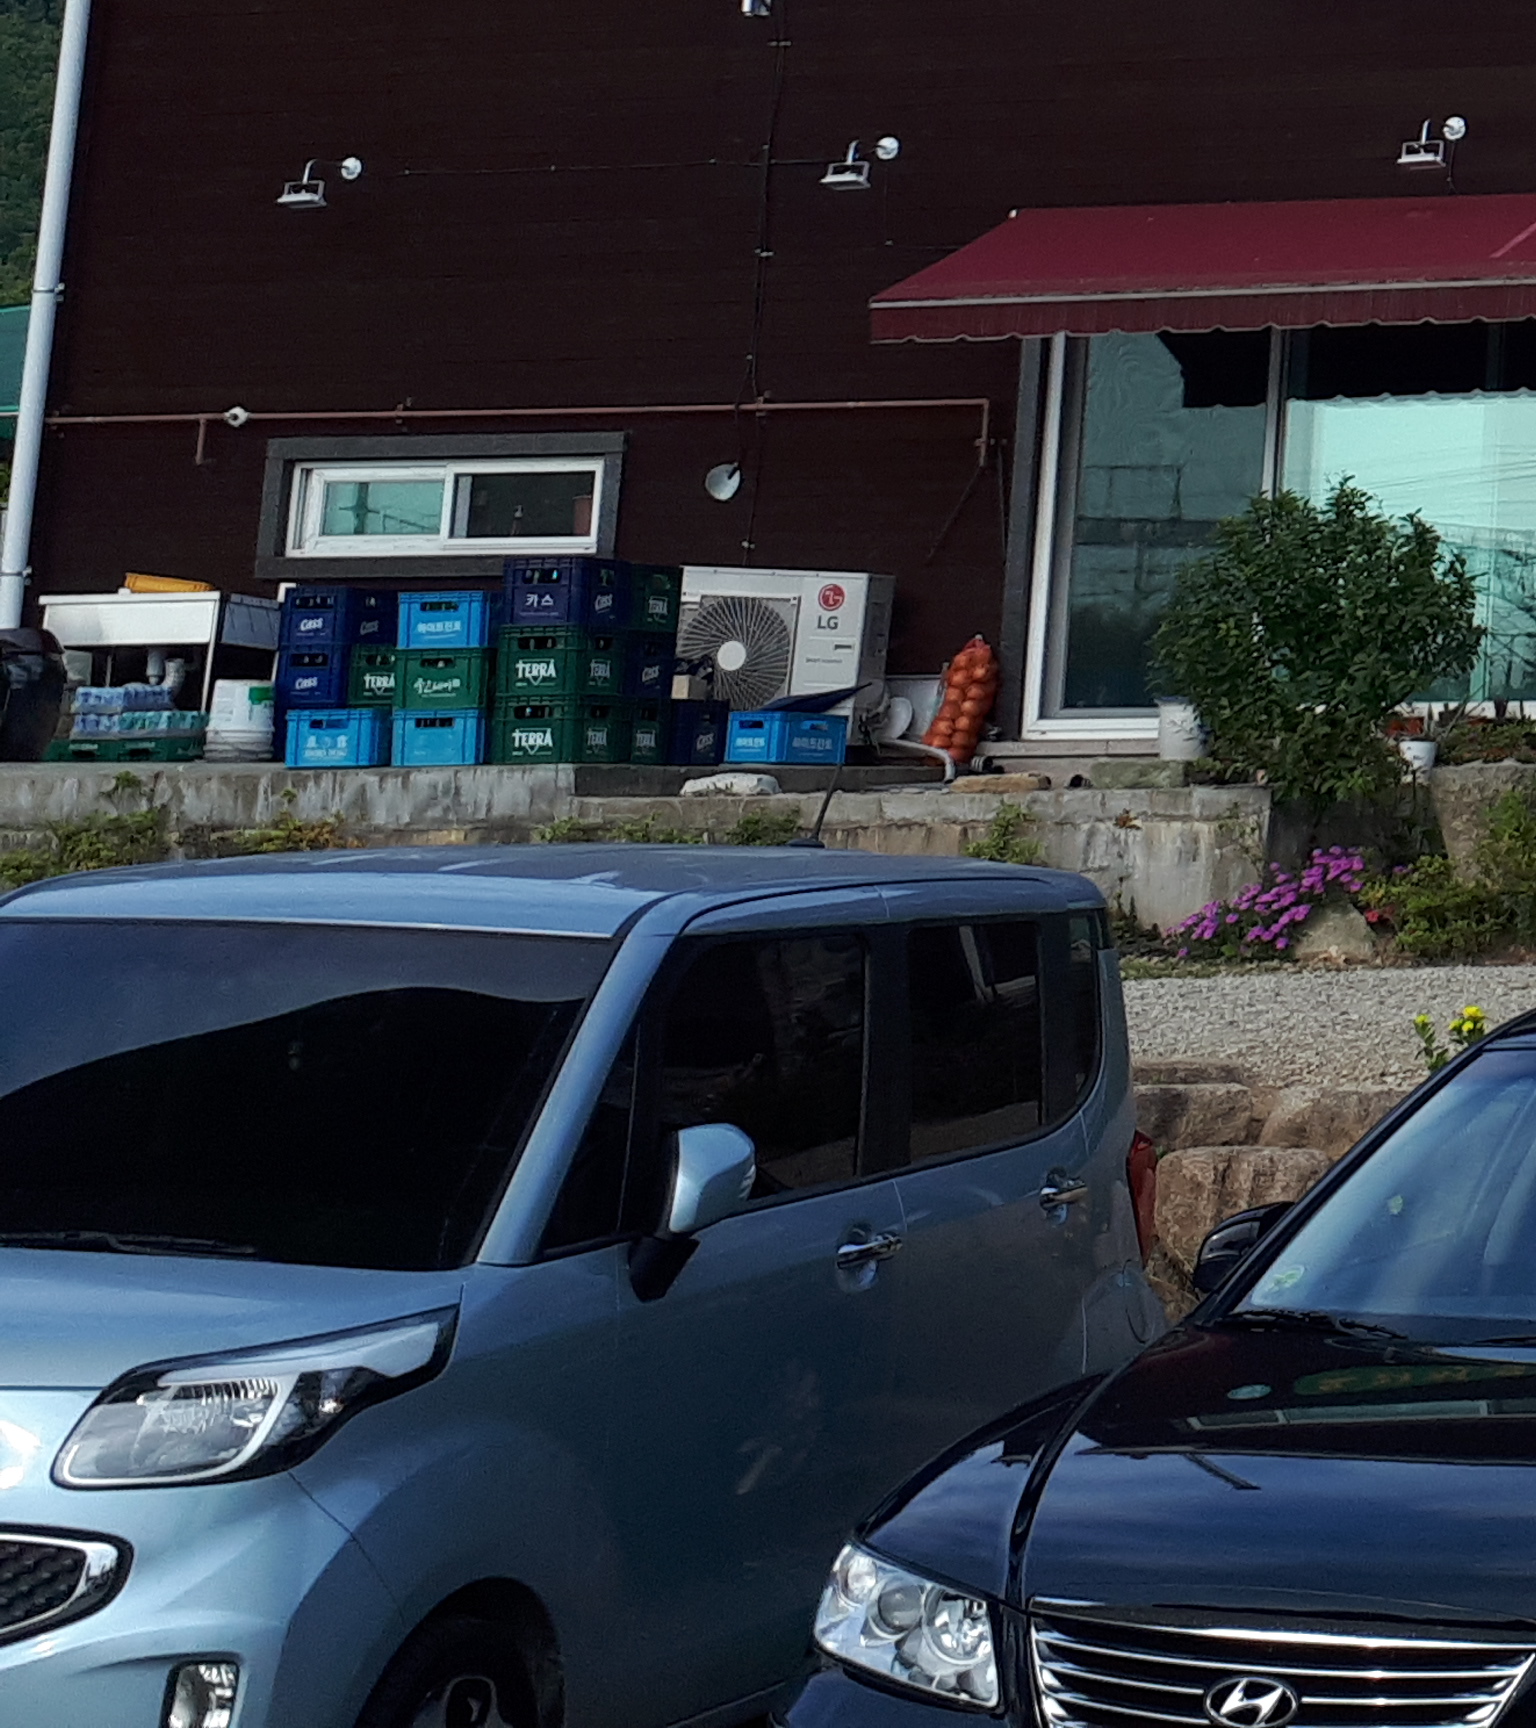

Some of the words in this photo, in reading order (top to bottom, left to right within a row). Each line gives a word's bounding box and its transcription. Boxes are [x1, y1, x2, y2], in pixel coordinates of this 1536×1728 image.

[525, 593, 554, 608] 카스
[300, 618, 323, 631] Cass
[817, 615, 839, 630] LG
[515, 659, 557, 679] TERRA
[295, 677, 318, 689] Cass
[512, 728, 553, 747] TERRA
